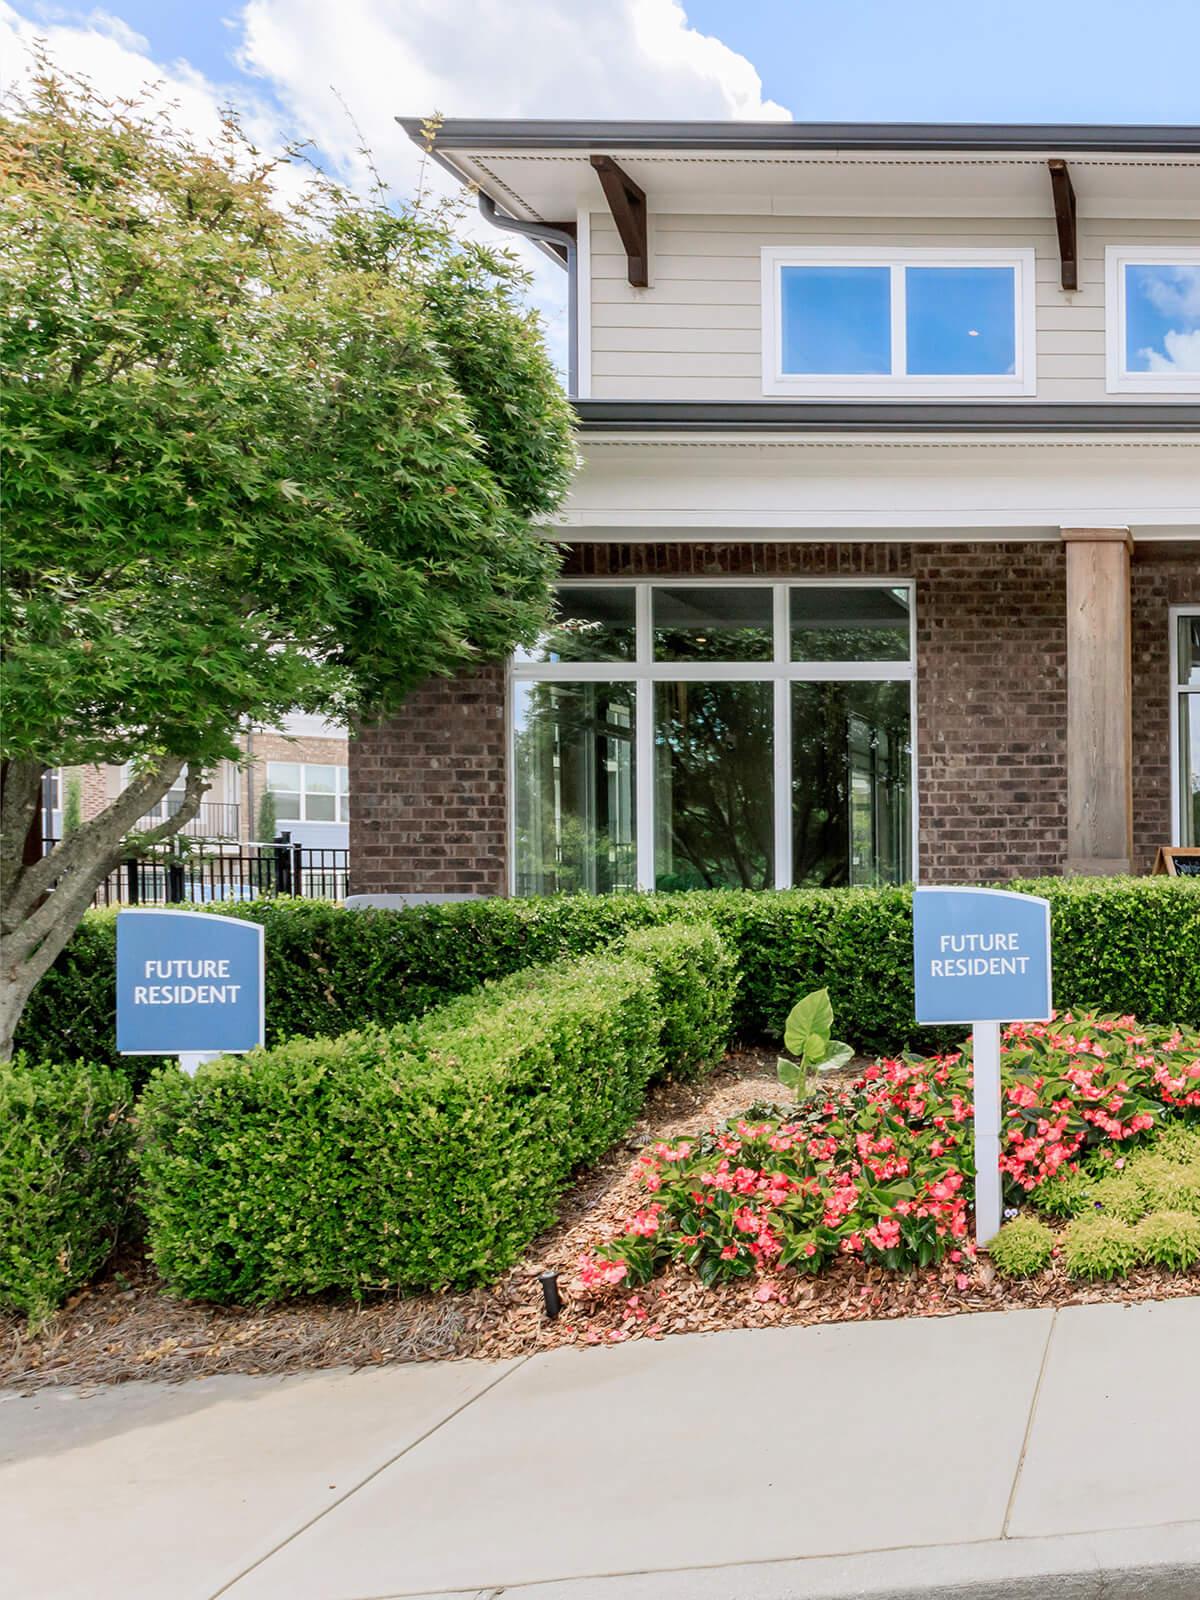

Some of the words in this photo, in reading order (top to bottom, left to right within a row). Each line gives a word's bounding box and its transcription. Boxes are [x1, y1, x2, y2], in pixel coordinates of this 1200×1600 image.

[940, 933, 1020, 953] FUTURE
[145, 960, 231, 979] FUTURE
[930, 957, 1030, 977] RESIDENT
[134, 985, 241, 1005] RESIDENT
